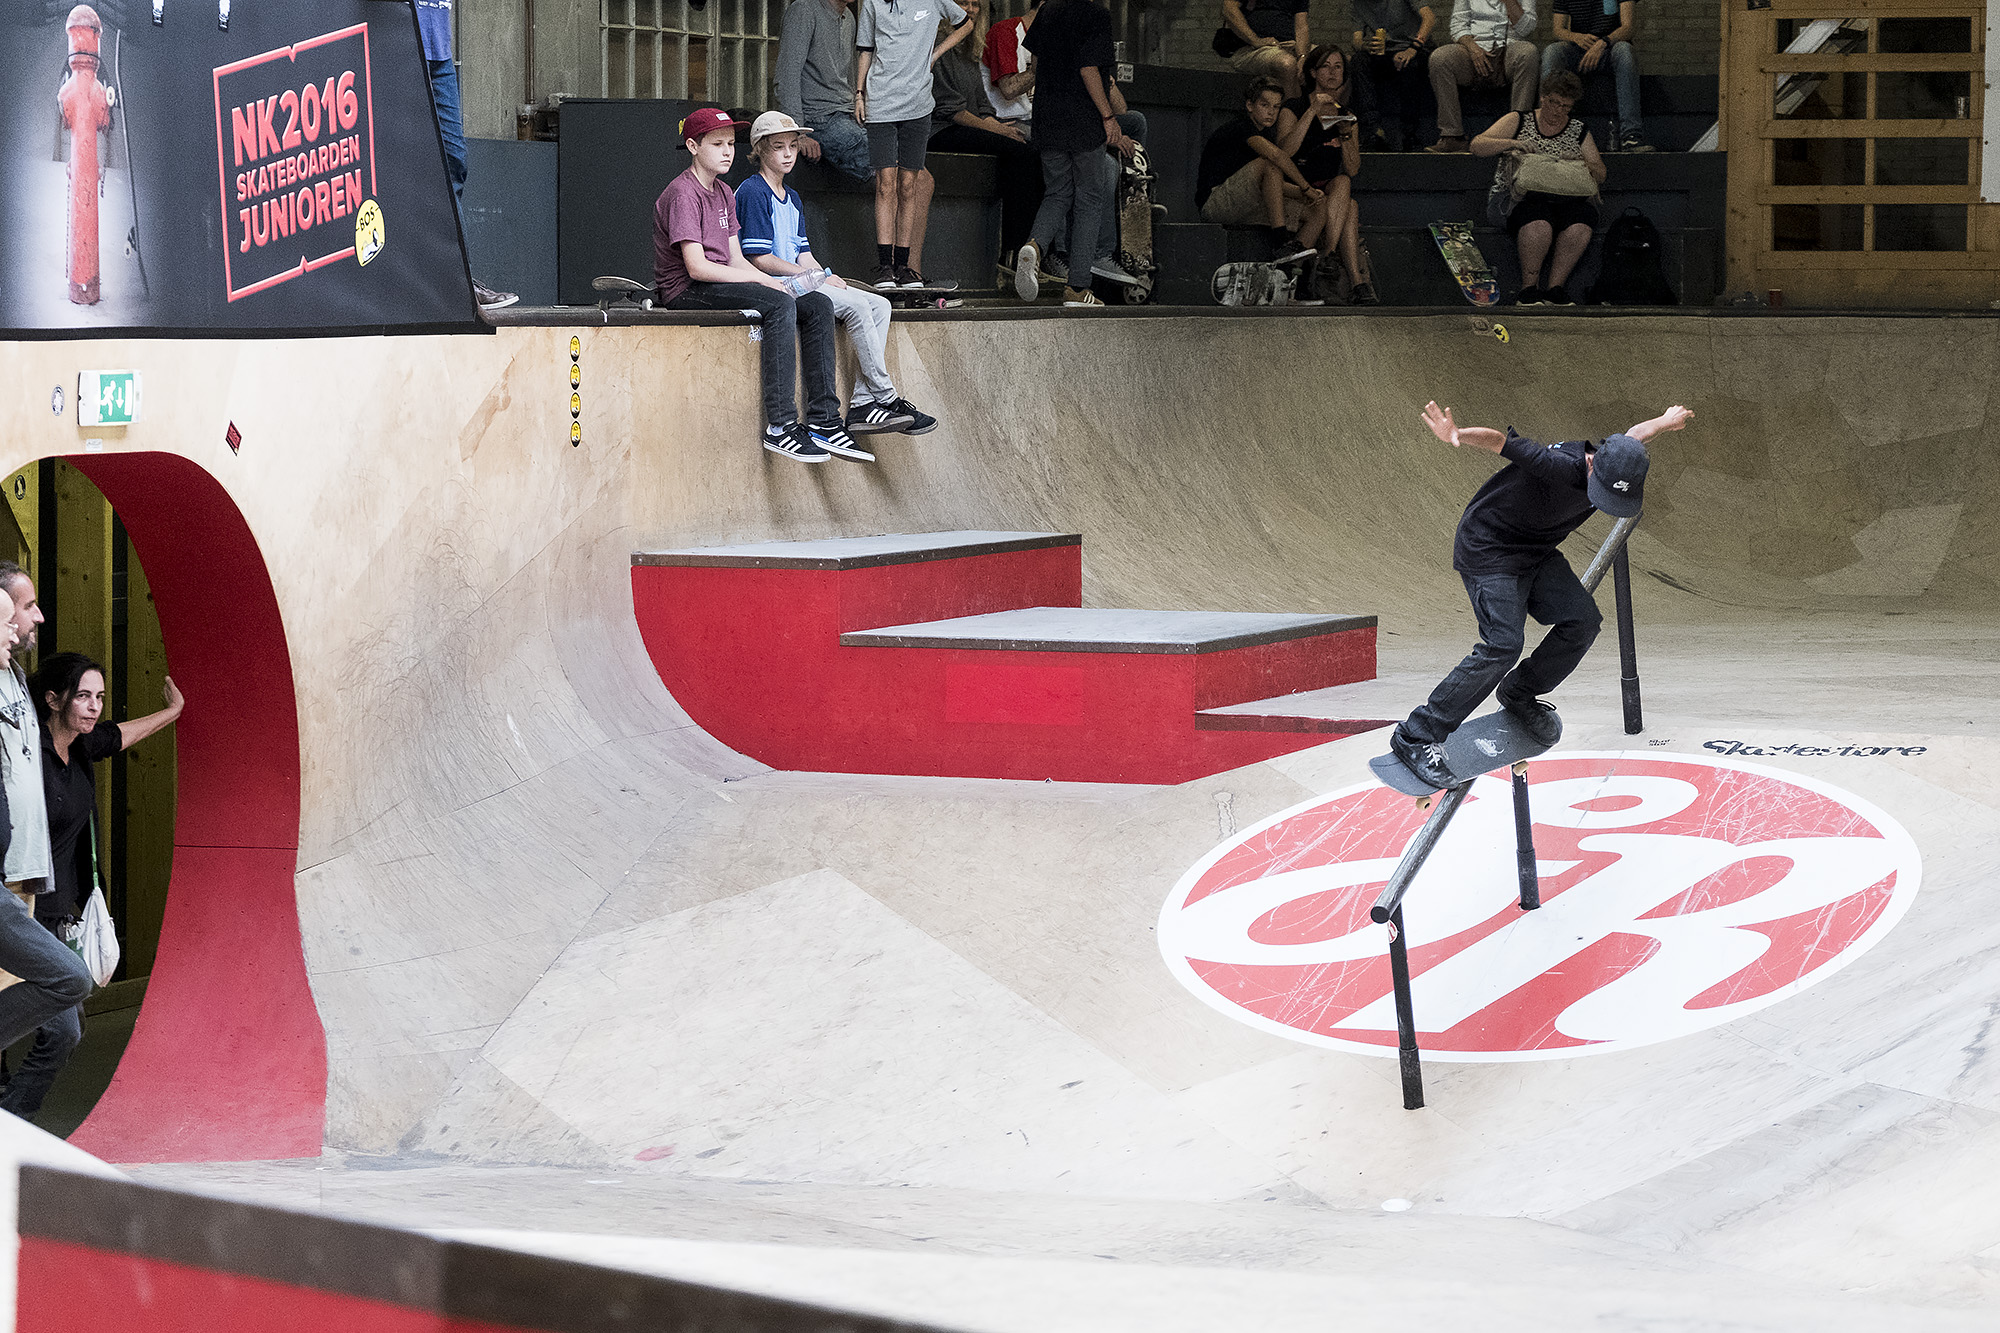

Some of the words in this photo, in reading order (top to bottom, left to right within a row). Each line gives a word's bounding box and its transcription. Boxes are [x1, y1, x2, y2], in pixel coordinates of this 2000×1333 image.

[232, 71, 358, 166] NK2016
[236, 134, 361, 201] SKATEBOARDEN
[239, 169, 363, 253] JUNIOREN
[359, 206, 375, 231] BOS
